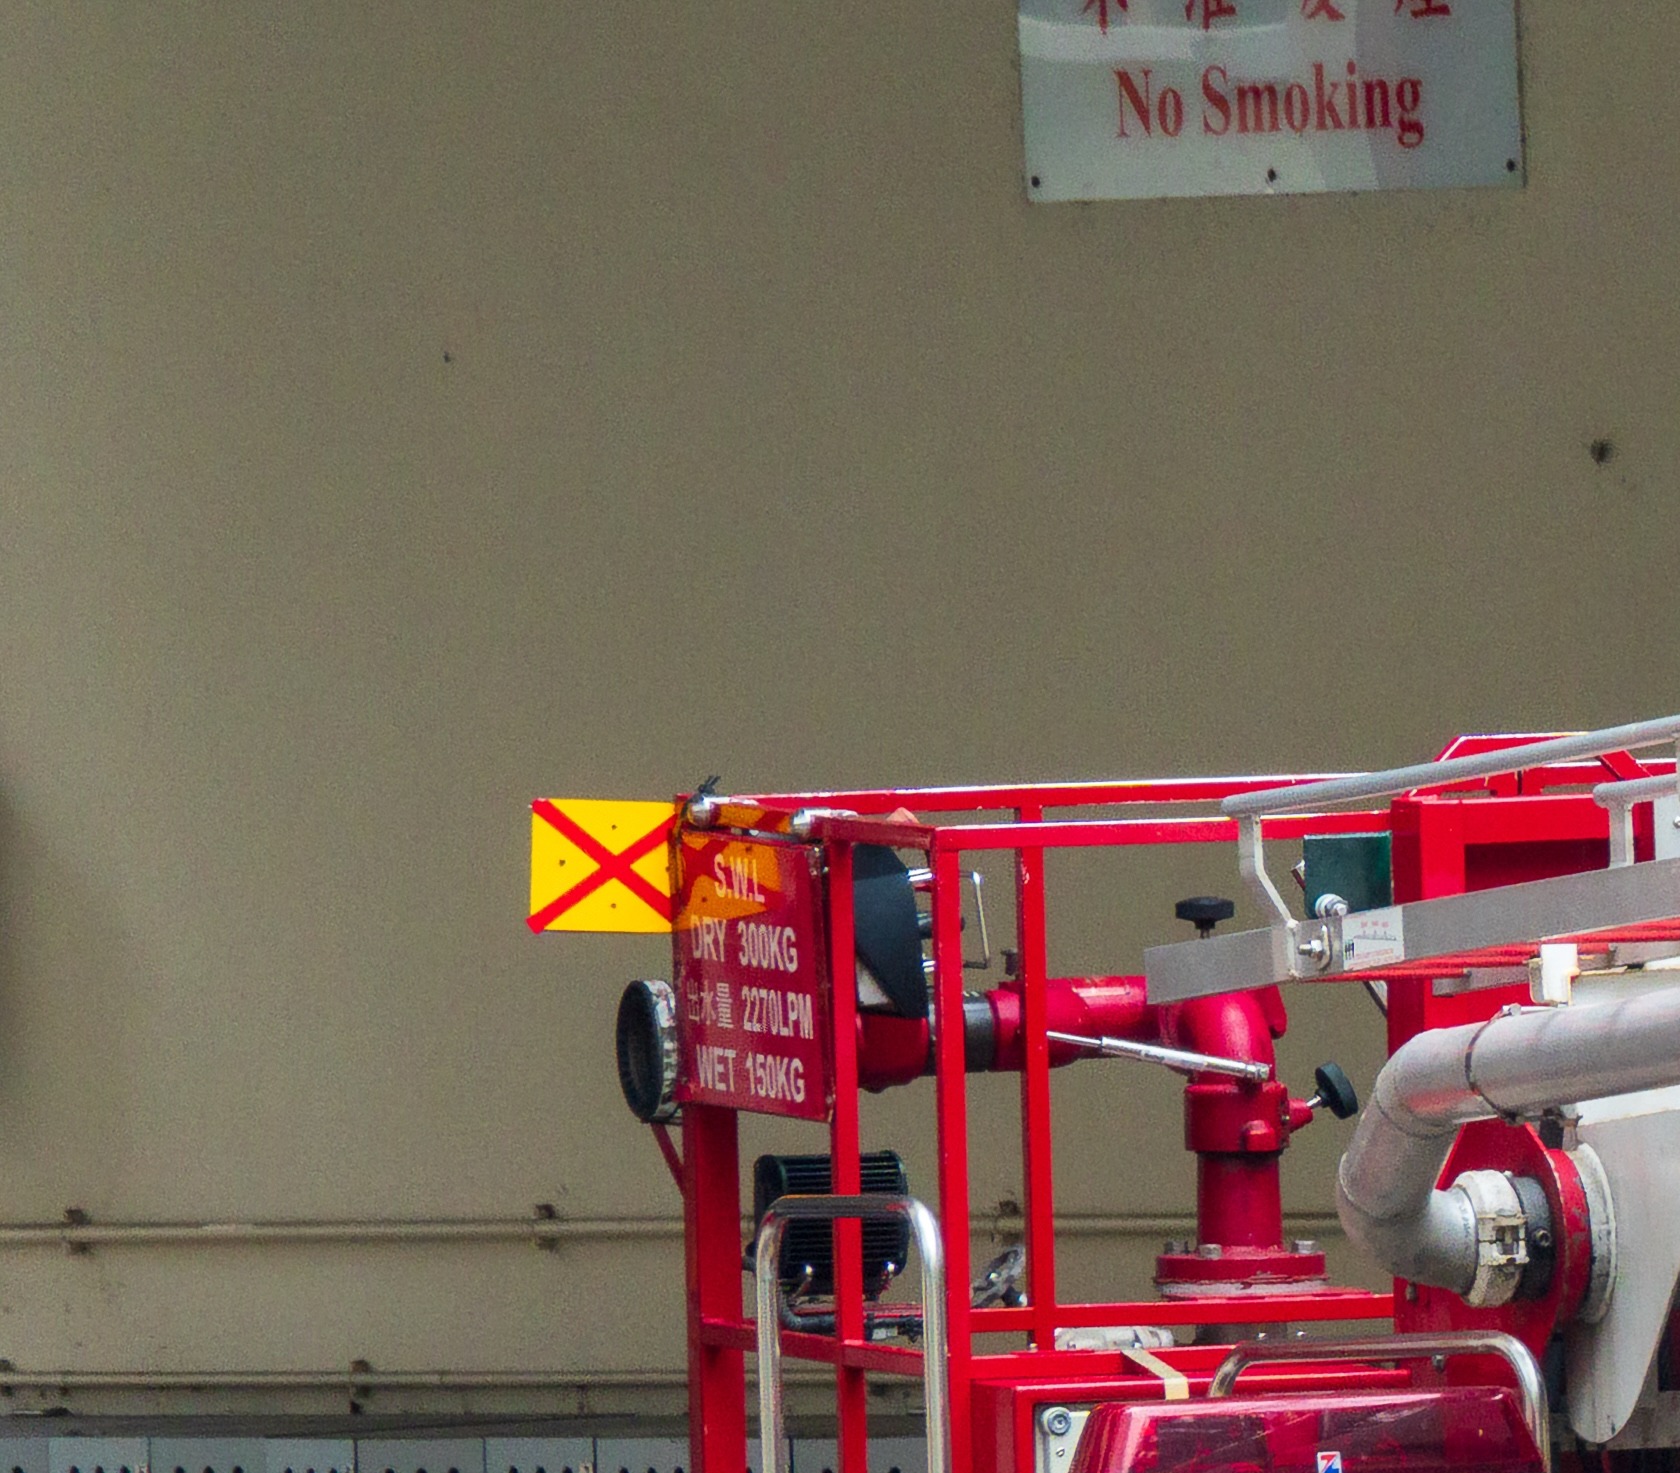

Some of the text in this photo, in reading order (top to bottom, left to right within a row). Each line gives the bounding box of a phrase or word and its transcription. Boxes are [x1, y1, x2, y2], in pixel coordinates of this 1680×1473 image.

[1114, 60, 1425, 149] No Smoking
[689, 914, 799, 973] DRY 300KG
[741, 985, 814, 1040] 2270LPM
[696, 1043, 806, 1103] WET 150KG
